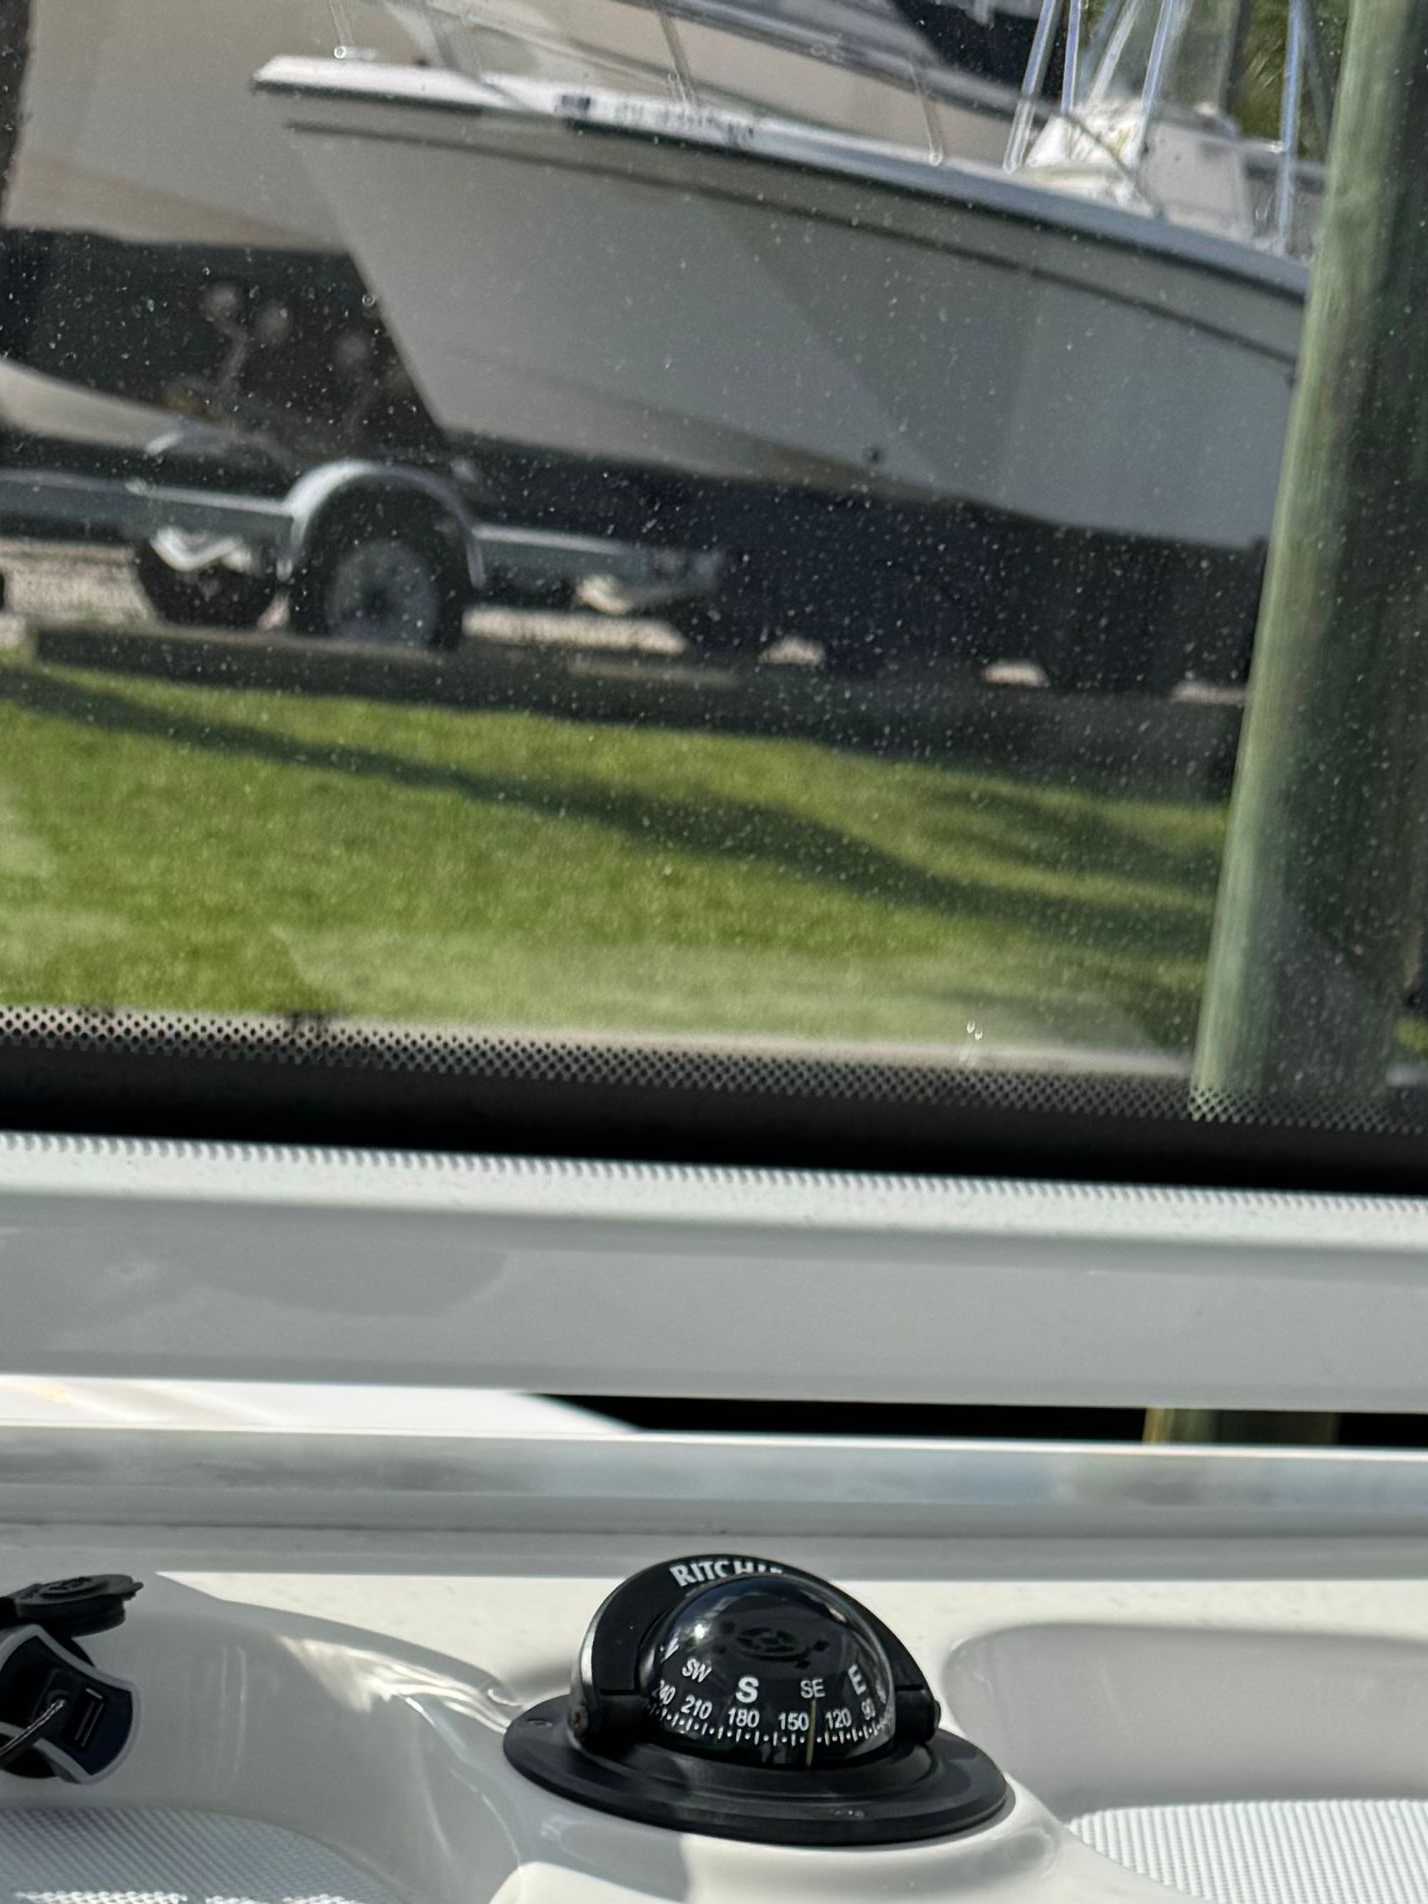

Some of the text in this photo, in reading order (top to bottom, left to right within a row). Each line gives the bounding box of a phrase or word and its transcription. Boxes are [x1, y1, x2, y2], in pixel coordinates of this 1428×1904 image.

[681, 1658, 866, 1703] SW S SE E
[680, 1694, 713, 1720] 210
[727, 1707, 760, 1728] 180
[778, 1711, 810, 1731] 150
[824, 1708, 852, 1728] 120
